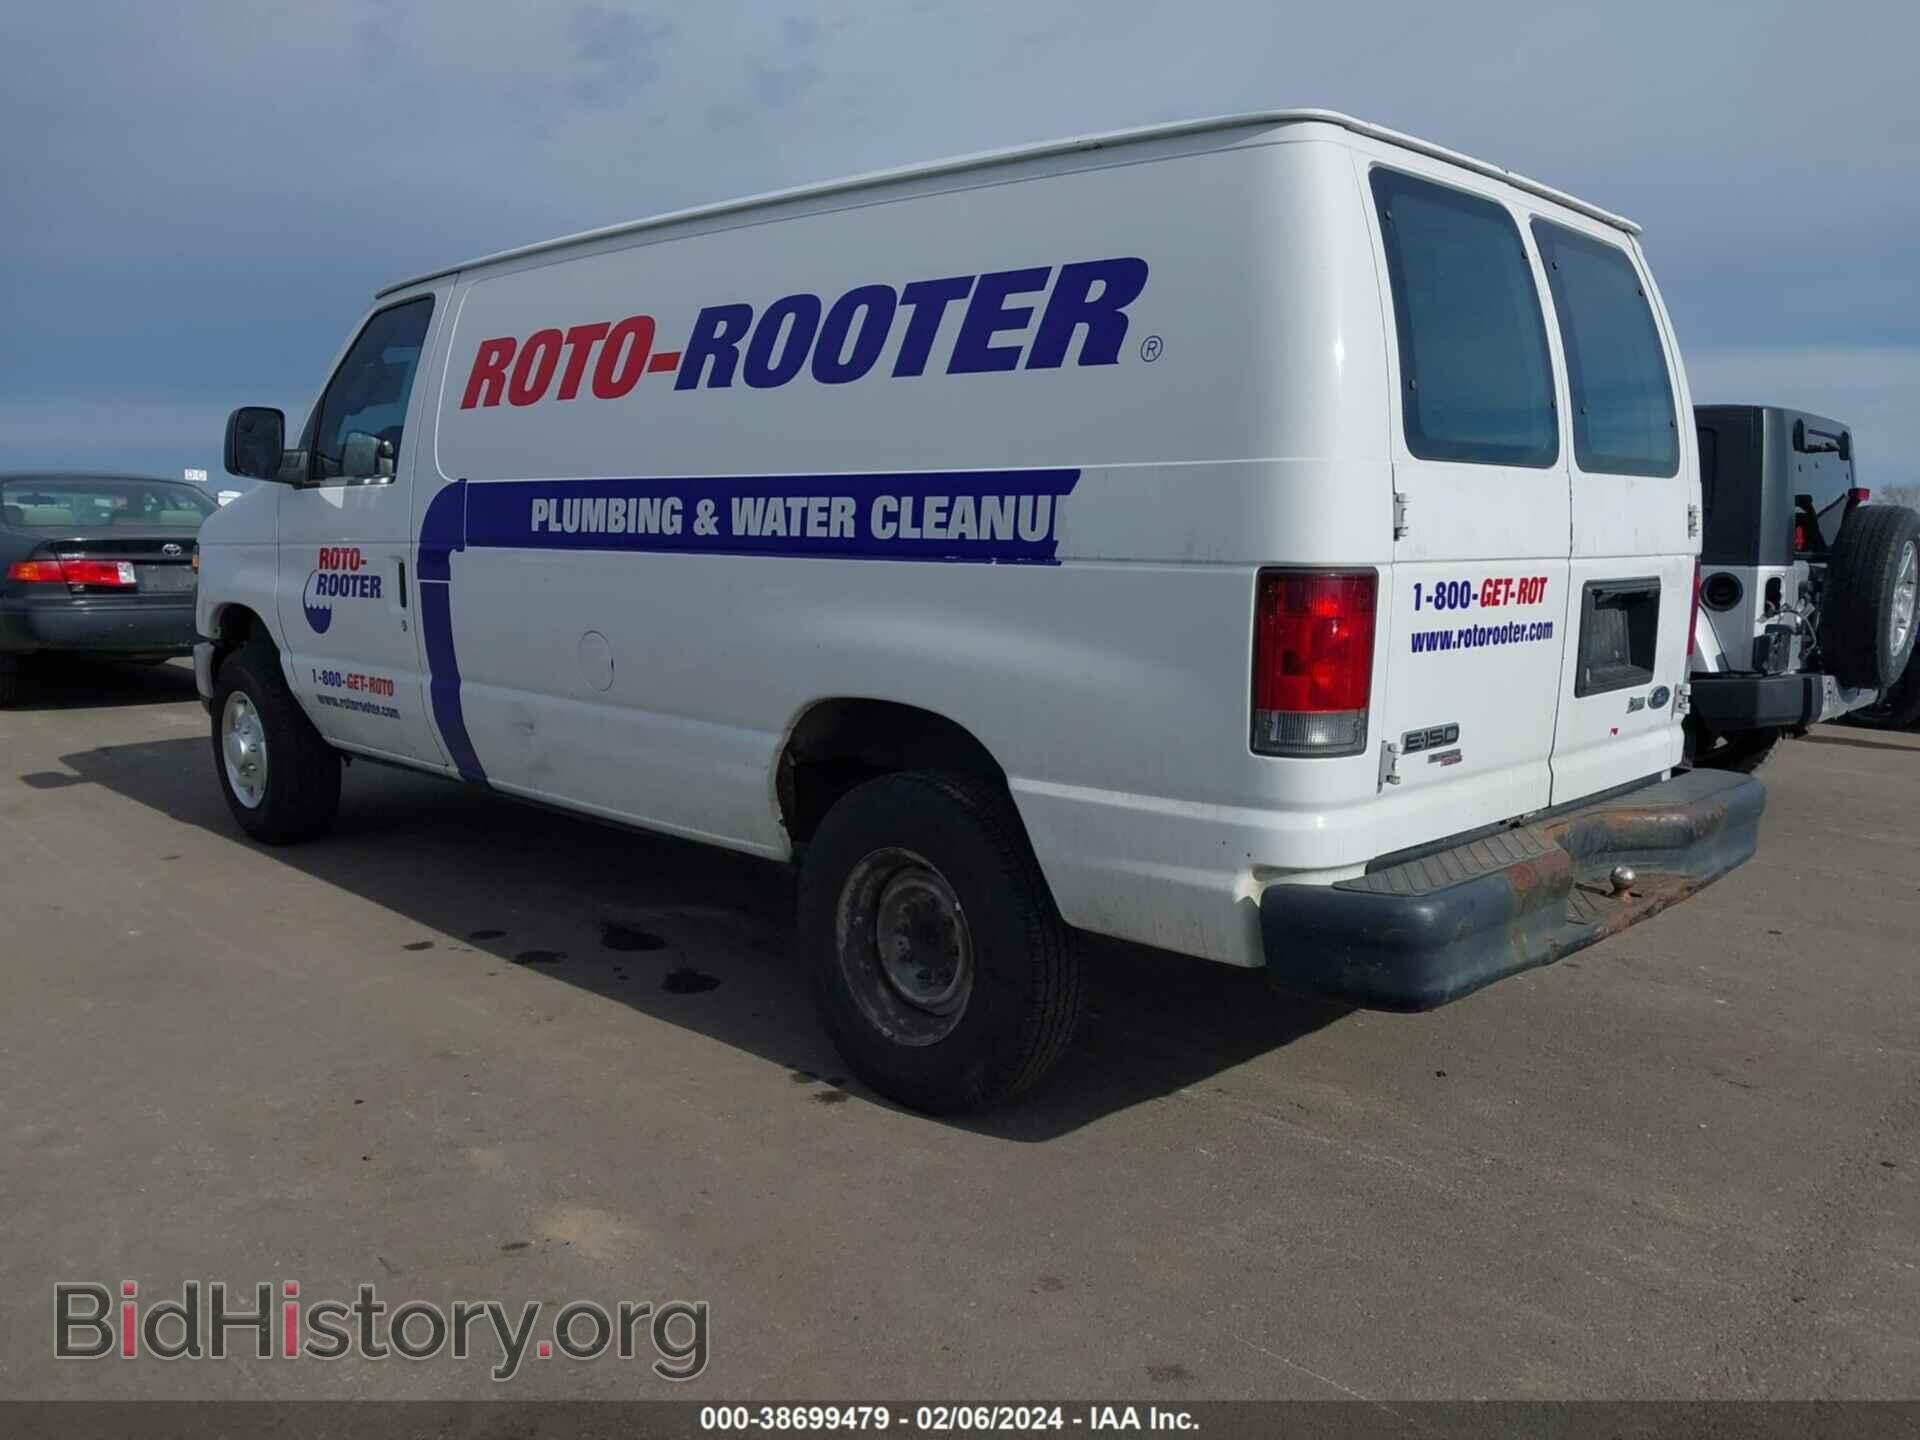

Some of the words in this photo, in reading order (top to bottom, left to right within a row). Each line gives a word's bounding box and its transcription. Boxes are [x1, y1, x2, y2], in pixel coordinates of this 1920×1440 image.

[460, 257, 1149, 410] ROTO-ROOTER
[530, 497, 683, 535] PLUMBING
[692, 497, 719, 535] &
[731, 495, 856, 538] WATER
[319, 547, 367, 571] ROTO-
[316, 573, 382, 599] ROOTER
[1413, 576, 1548, 611] 1-800-GET-ROT
[1411, 621, 1553, 653] www.rotorooter.com
[312, 668, 394, 697] 1-800-GET-ROTO
